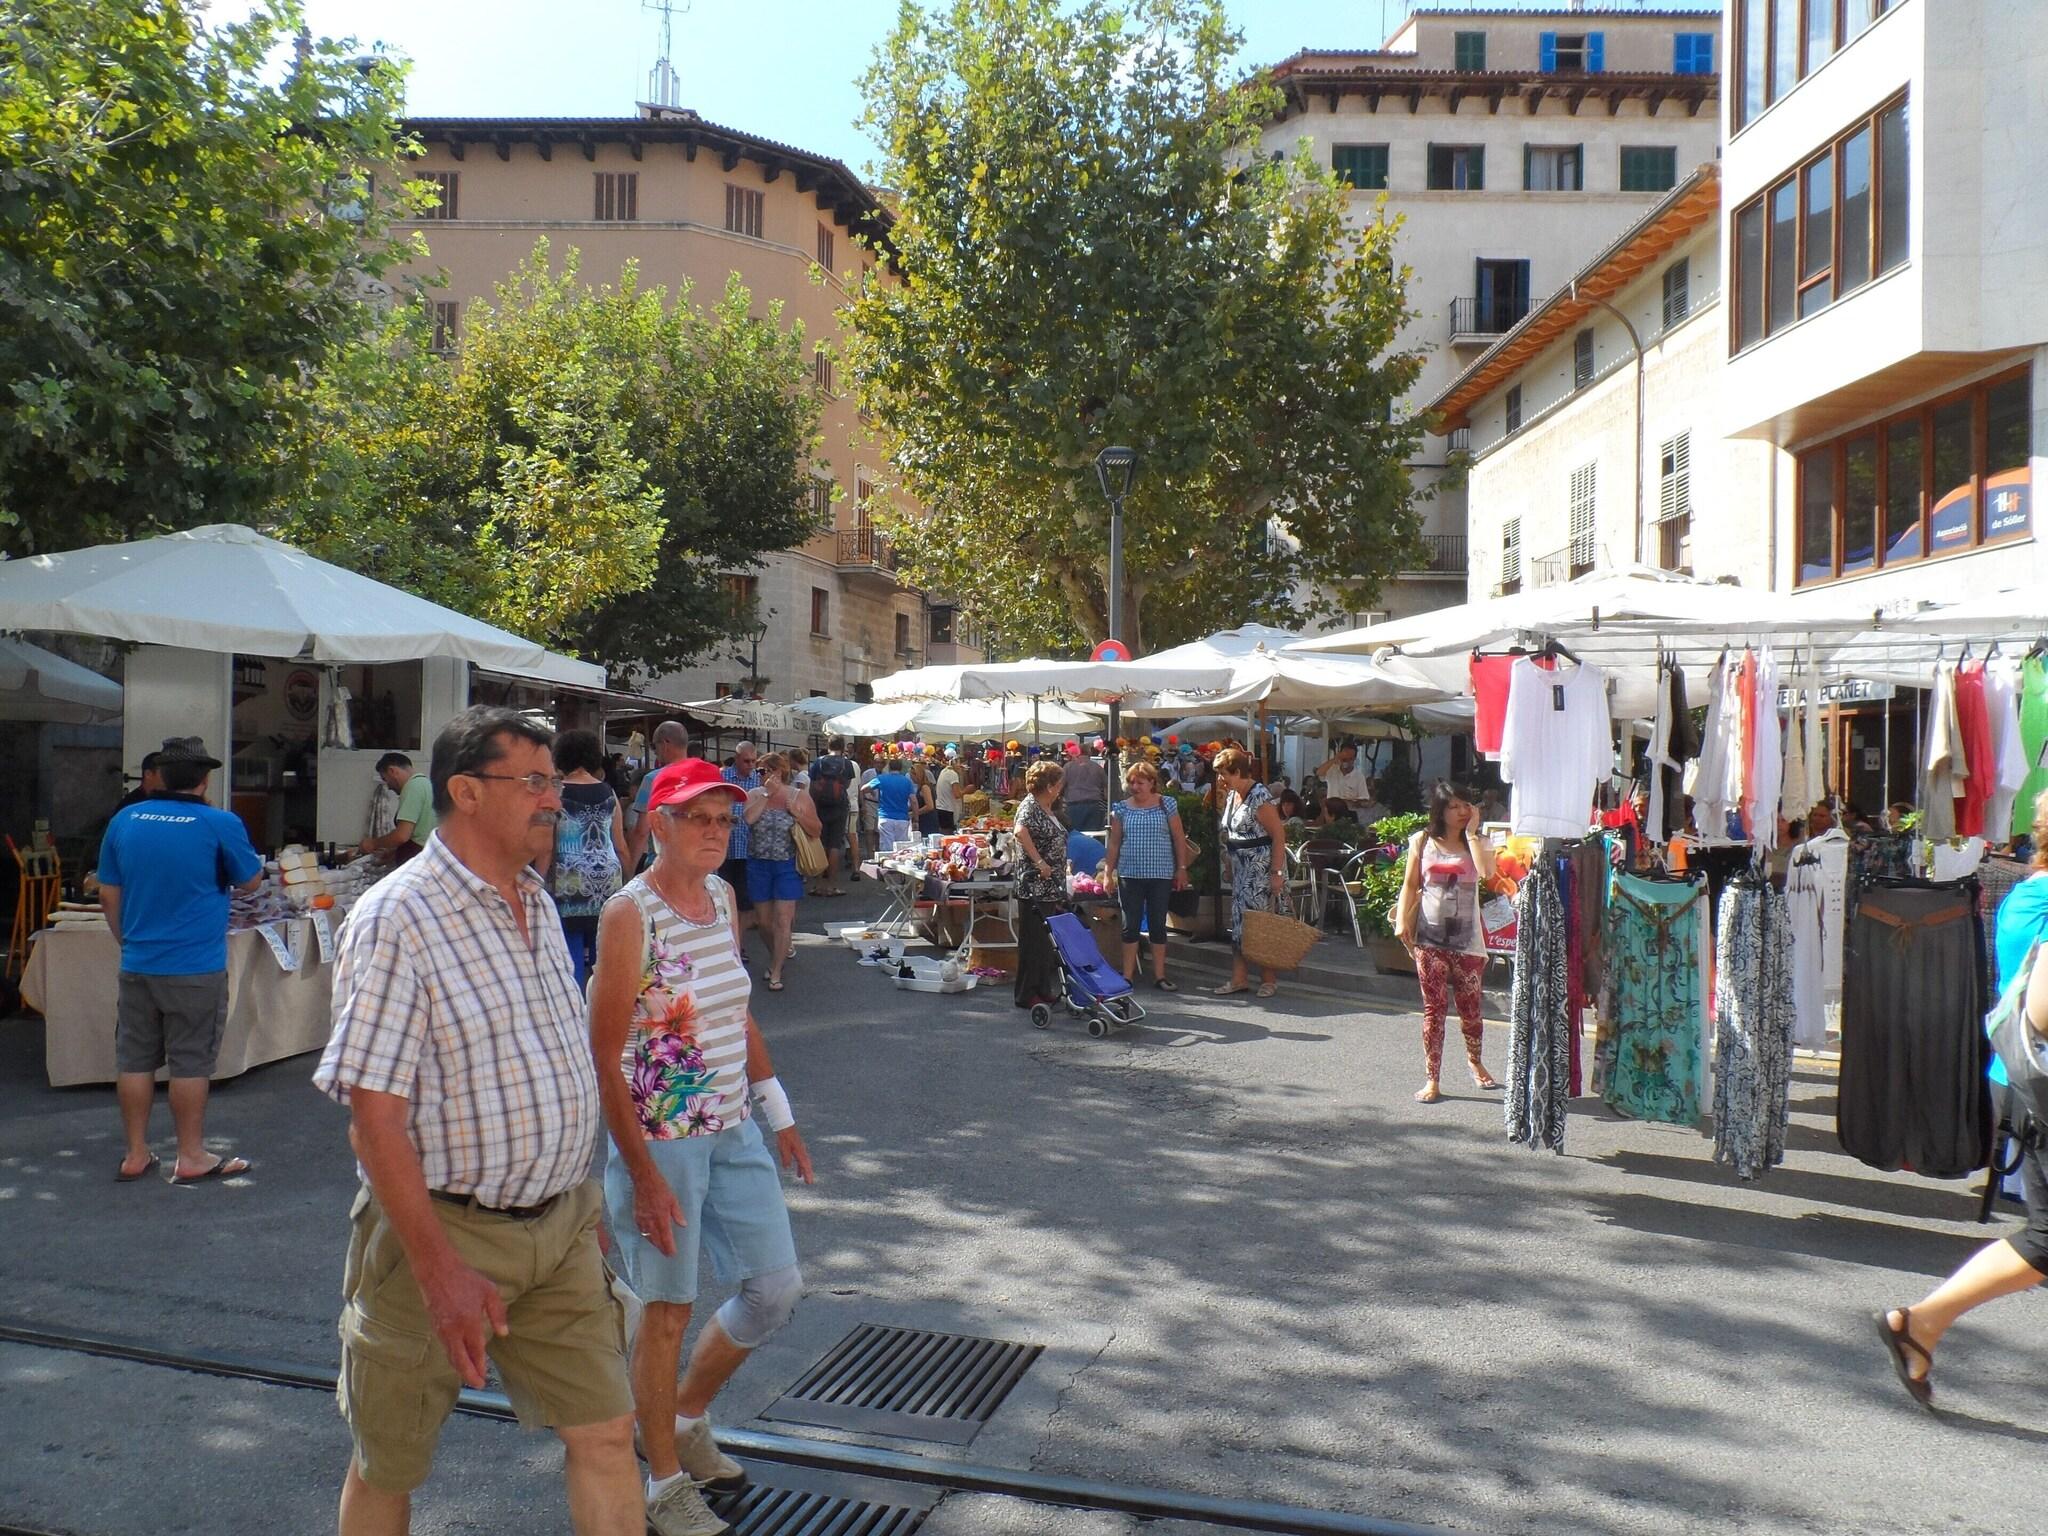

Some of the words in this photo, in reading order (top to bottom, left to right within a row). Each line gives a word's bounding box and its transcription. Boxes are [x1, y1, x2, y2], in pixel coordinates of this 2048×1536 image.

[1819, 682, 1870, 701] PLANET
[139, 813, 198, 823] DUNLOP
[1488, 935, 1518, 949] L'espe
